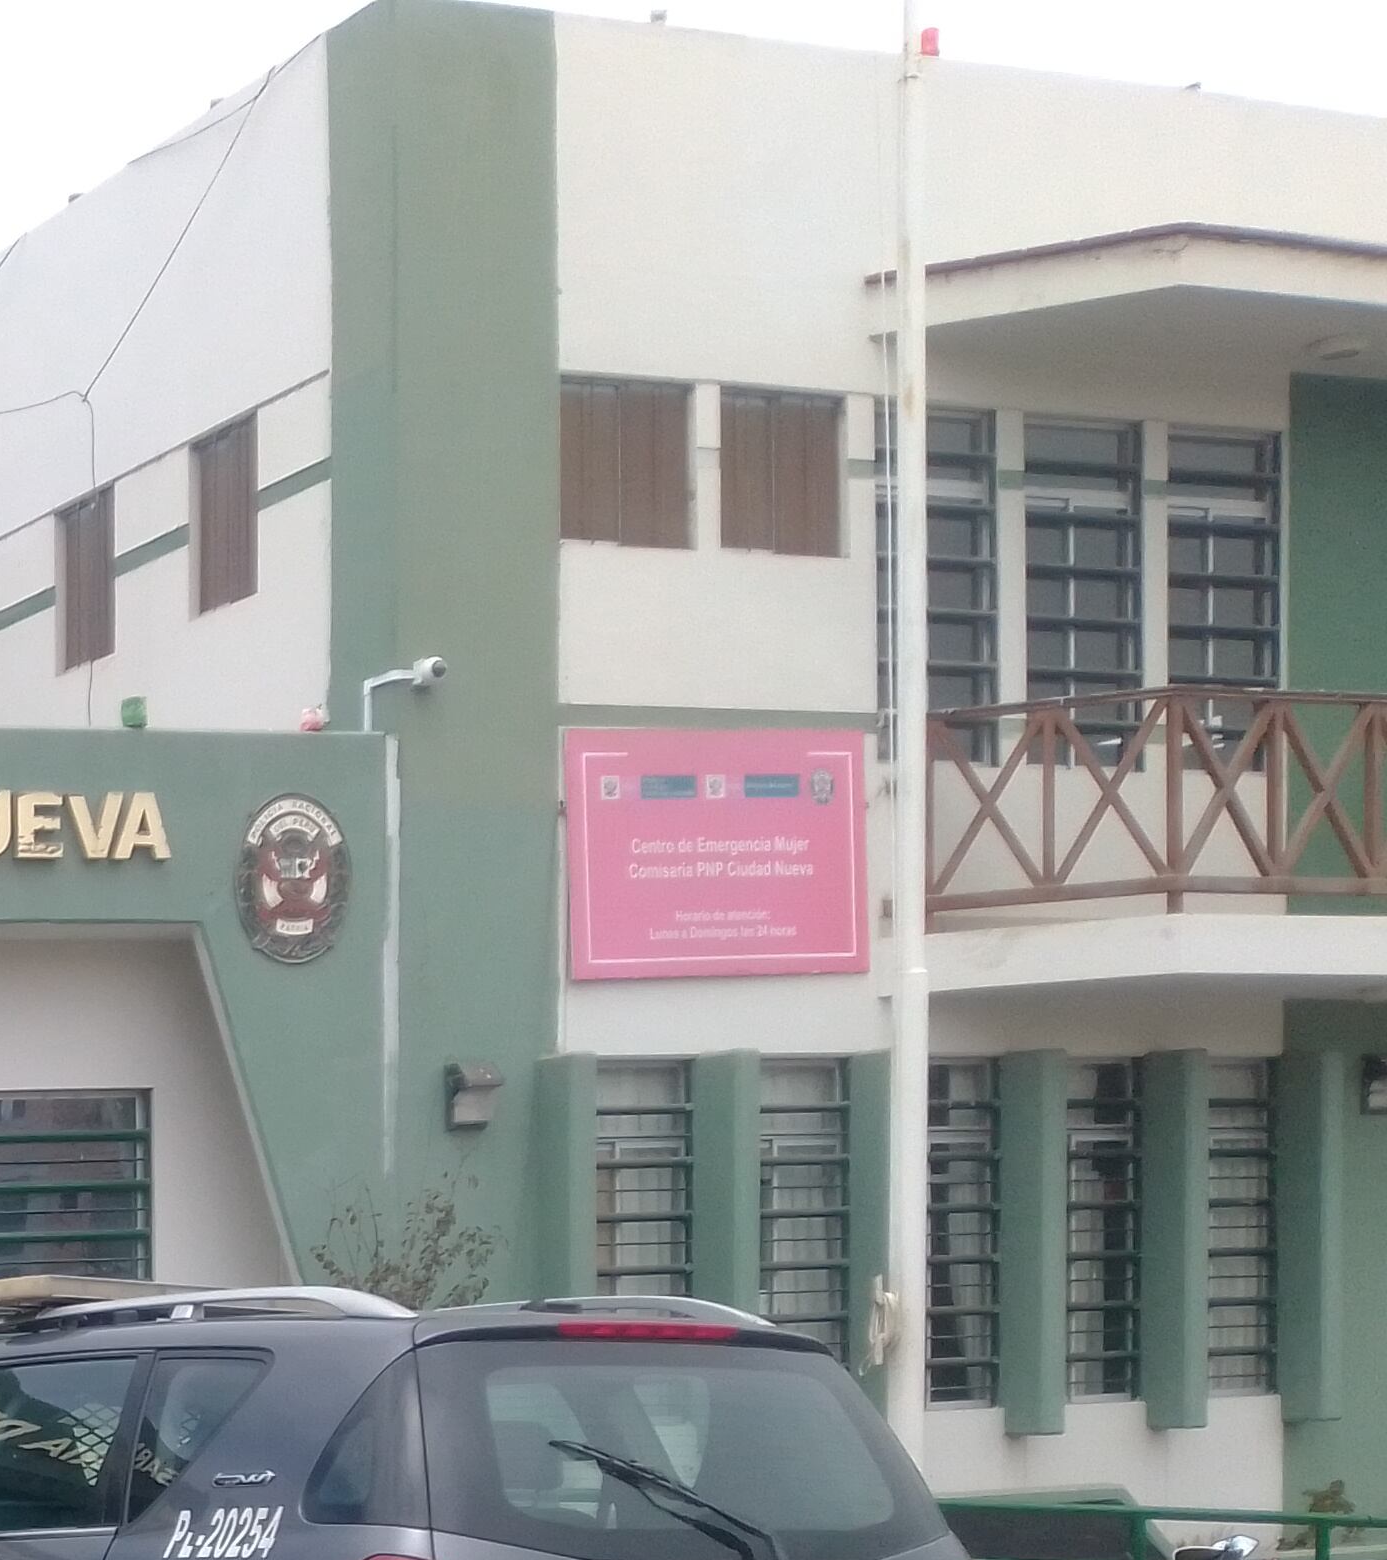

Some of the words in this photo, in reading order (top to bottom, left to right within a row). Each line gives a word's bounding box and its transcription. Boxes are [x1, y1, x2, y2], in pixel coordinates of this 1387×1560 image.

[632, 838, 675, 854] Centro
[678, 838, 693, 853] de
[698, 837, 771, 855] Emergencia
[774, 836, 810, 855] Mujer
[697, 862, 723, 878] PNP
[727, 860, 771, 877] Ciudad
[774, 860, 814, 876] Nueva
